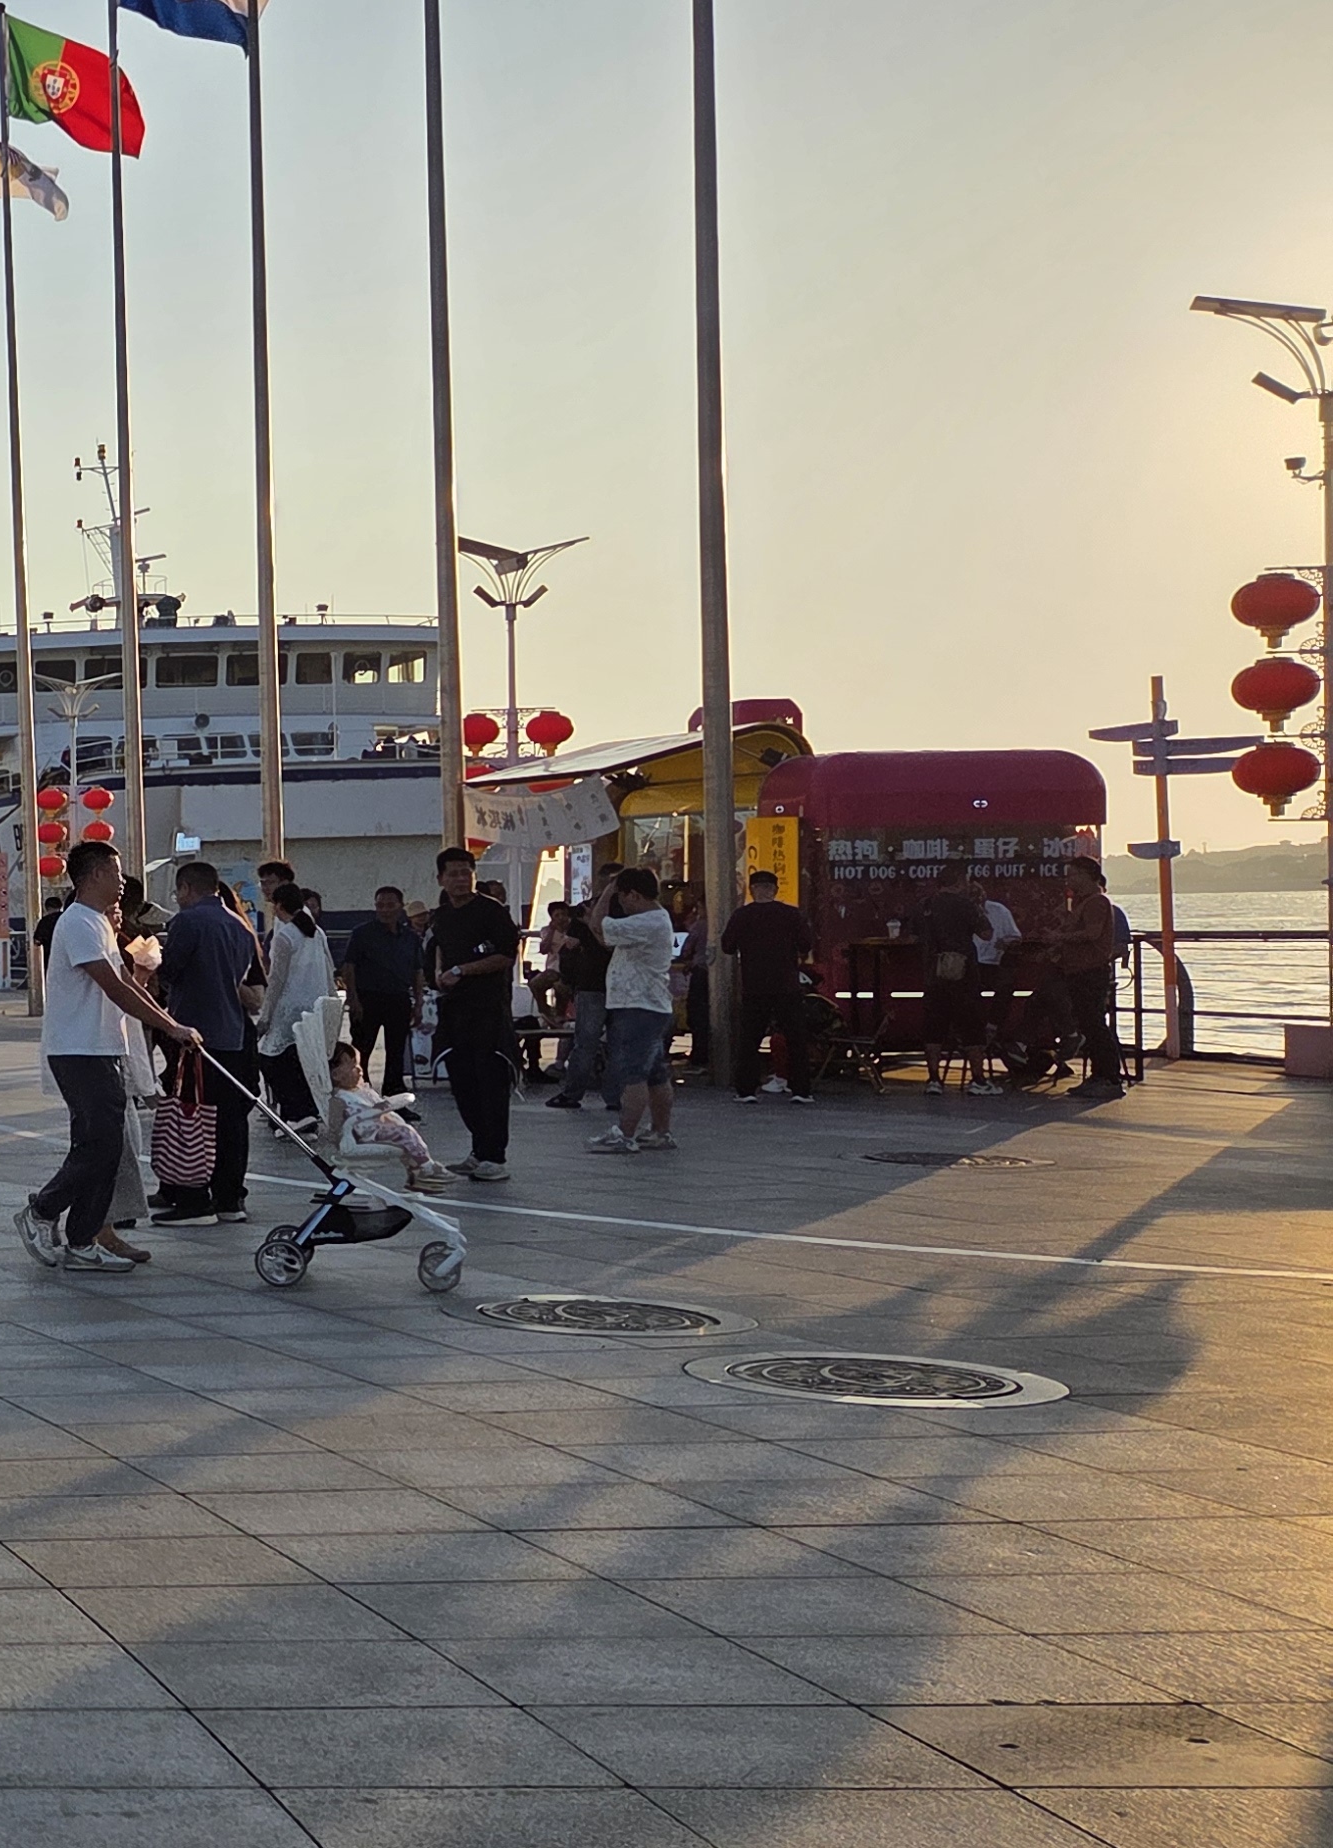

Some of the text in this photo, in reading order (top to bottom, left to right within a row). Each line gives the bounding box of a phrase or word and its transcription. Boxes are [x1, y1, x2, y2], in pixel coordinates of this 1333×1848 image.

[828, 839, 879, 861] 热狗
[902, 838, 949, 860] 咖啡
[974, 837, 1020, 859] 蛋仔
[834, 866, 865, 879] HOT
[870, 866, 896, 879] DOG
[995, 864, 1026, 877] PUFF
[1039, 863, 1058, 877] ICE
